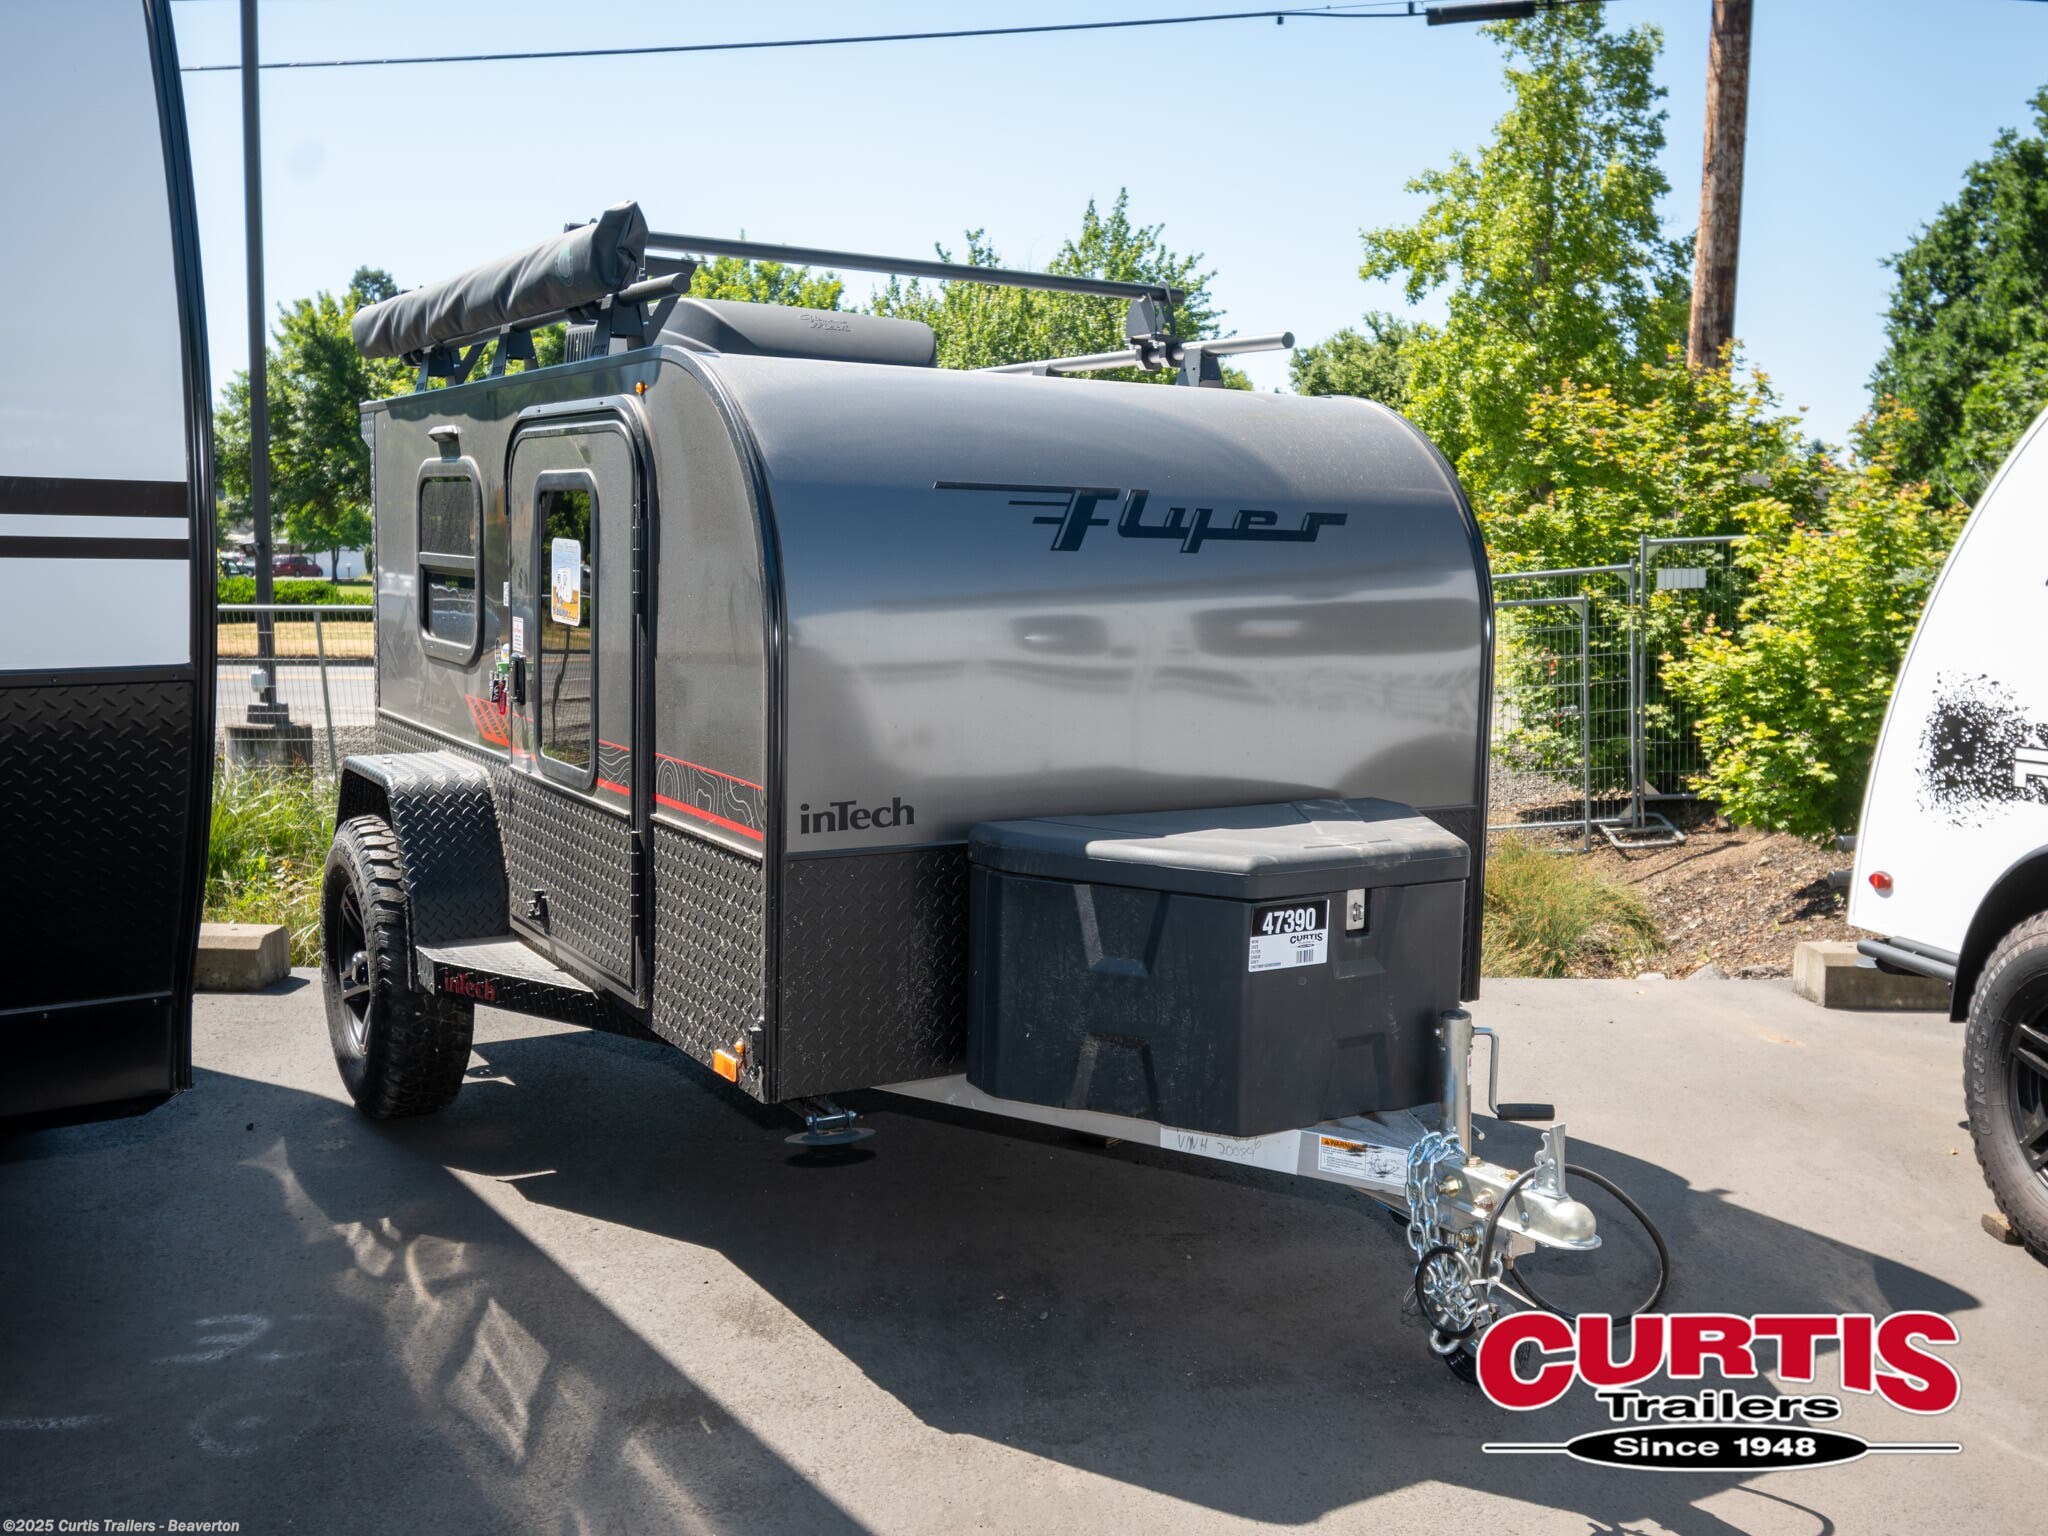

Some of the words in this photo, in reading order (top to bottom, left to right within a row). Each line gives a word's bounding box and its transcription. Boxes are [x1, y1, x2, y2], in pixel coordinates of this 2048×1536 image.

[932, 480, 1348, 554] Flyer
[800, 796, 915, 835] inTech
[1262, 907, 1316, 935] 47390
[1289, 932, 1323, 945] CURTIS
[444, 968, 497, 1002] inTech
